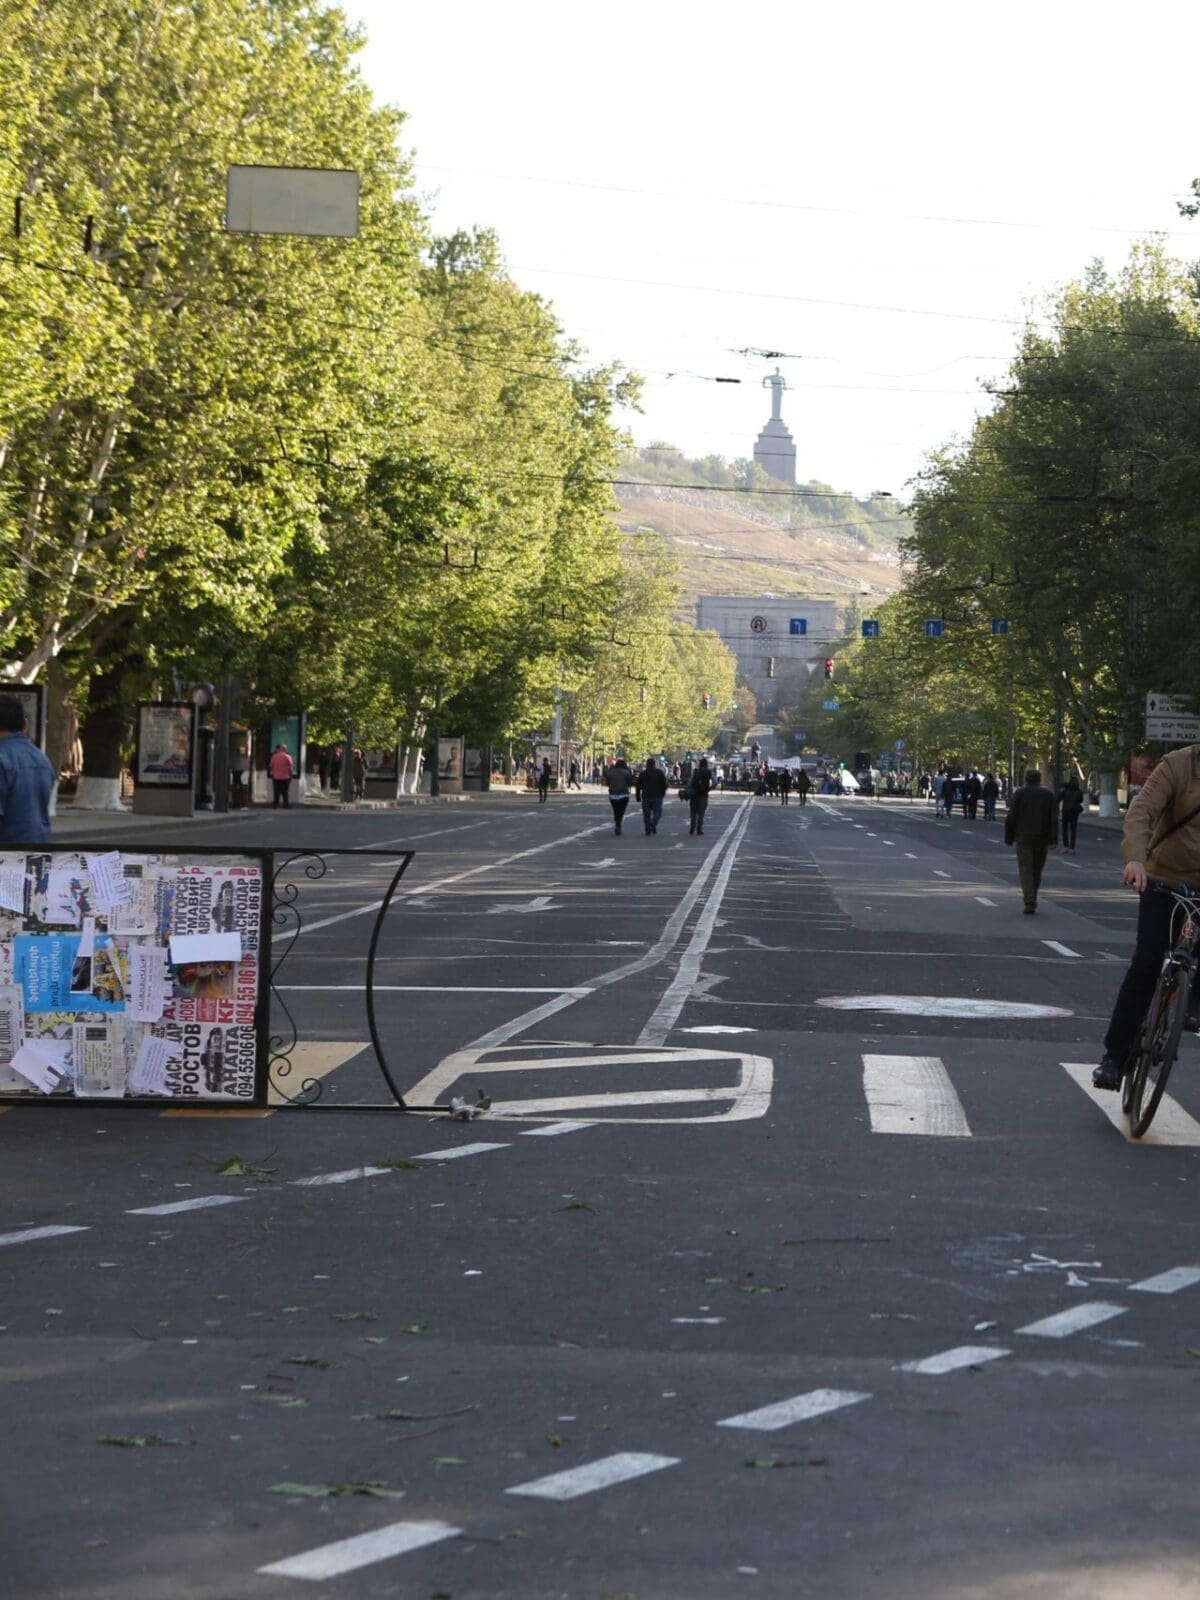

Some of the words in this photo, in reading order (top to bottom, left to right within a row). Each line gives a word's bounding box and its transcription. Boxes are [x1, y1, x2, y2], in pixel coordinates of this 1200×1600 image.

[249, 879, 260, 893] 06
[187, 877, 200, 936] РМАВИР
[198, 877, 212, 935] АВРОПОЛЬ
[248, 895, 260, 911] 06
[247, 912, 259, 927] 55
[246, 929, 258, 950] 094
[238, 970, 256, 985] 06
[237, 986, 256, 1001] 55
[235, 1003, 254, 1024] 094
[240, 1025, 255, 1040] 06
[239, 1041, 255, 1057] 06
[182, 1024, 201, 1096] РОСТОВ
[223, 1026, 240, 1097] АНАПА
[239, 1058, 254, 1074] 55
[238, 1075, 253, 1097] 094
